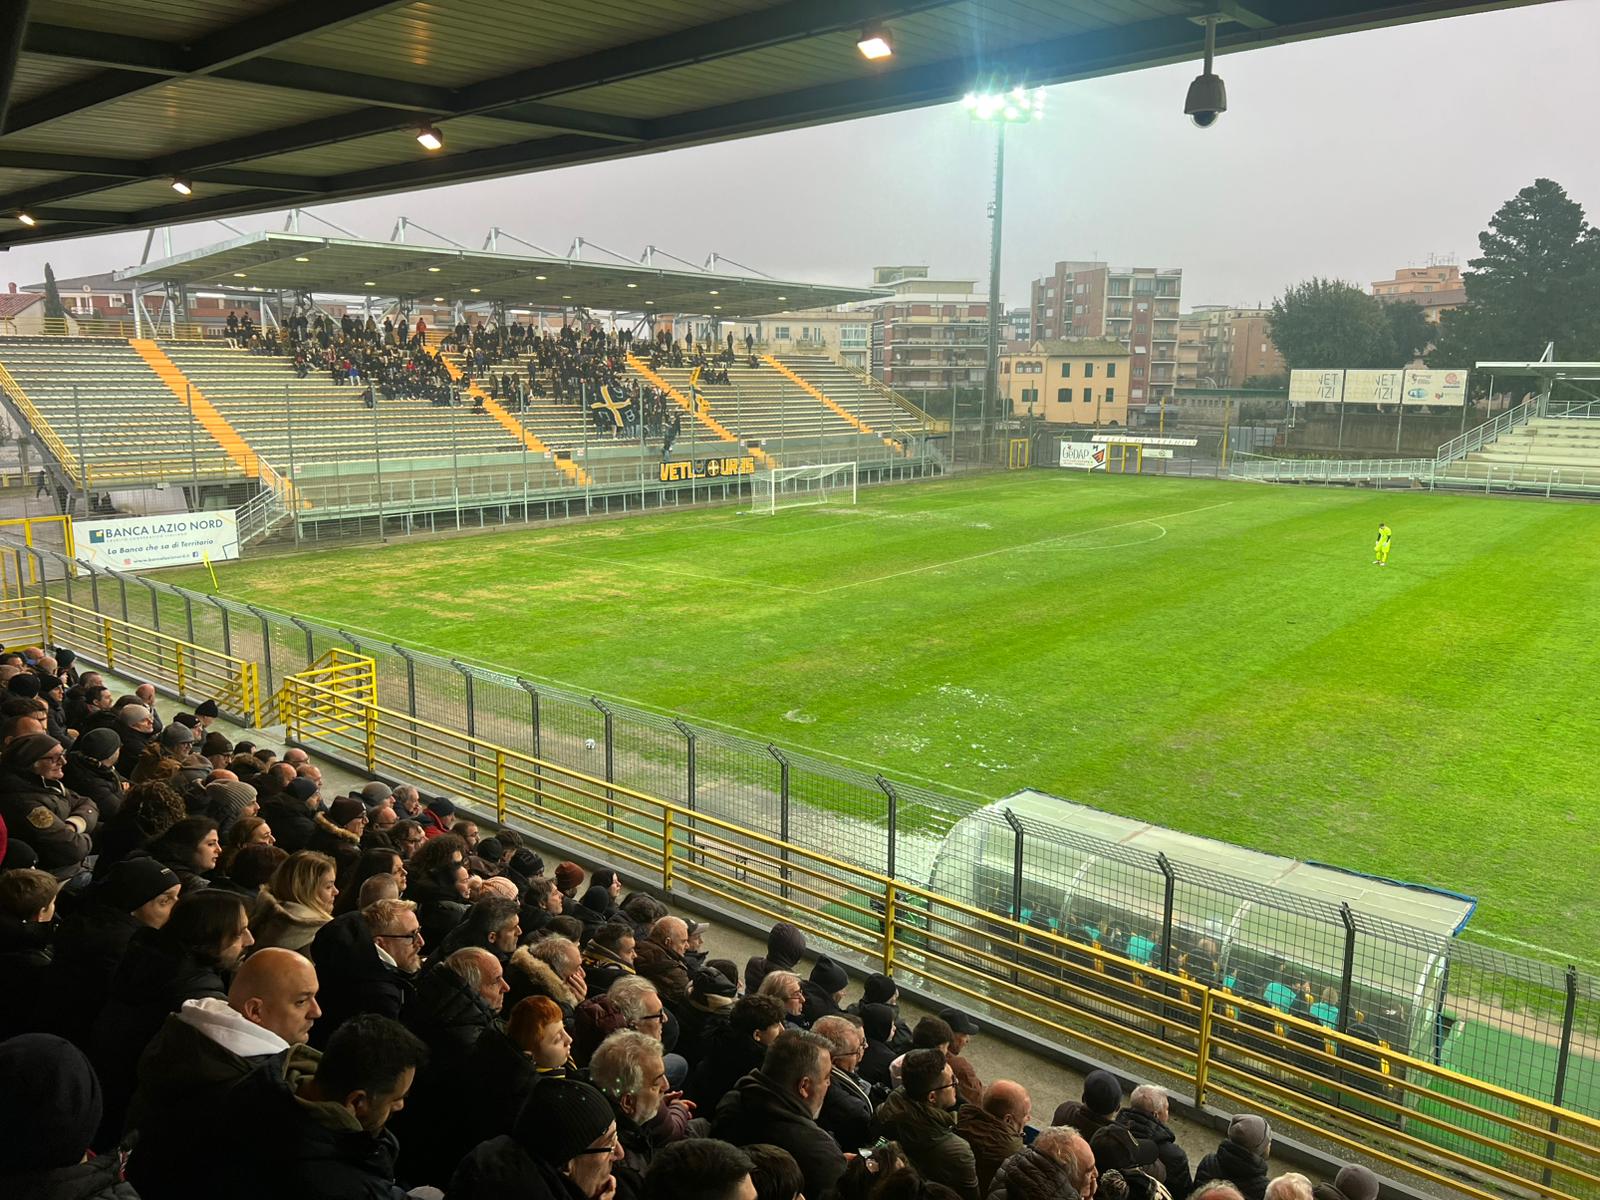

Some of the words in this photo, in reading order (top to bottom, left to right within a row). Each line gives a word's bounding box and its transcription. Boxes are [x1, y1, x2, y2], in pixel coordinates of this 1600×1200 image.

[105, 525, 150, 539] BANCA
[151, 522, 187, 534] LAZIO
[189, 519, 223, 531] NORD
[119, 546, 144, 554] Banca
[145, 543, 159, 551] che
[171, 541, 180, 549] di
[181, 538, 214, 548] Territorio
